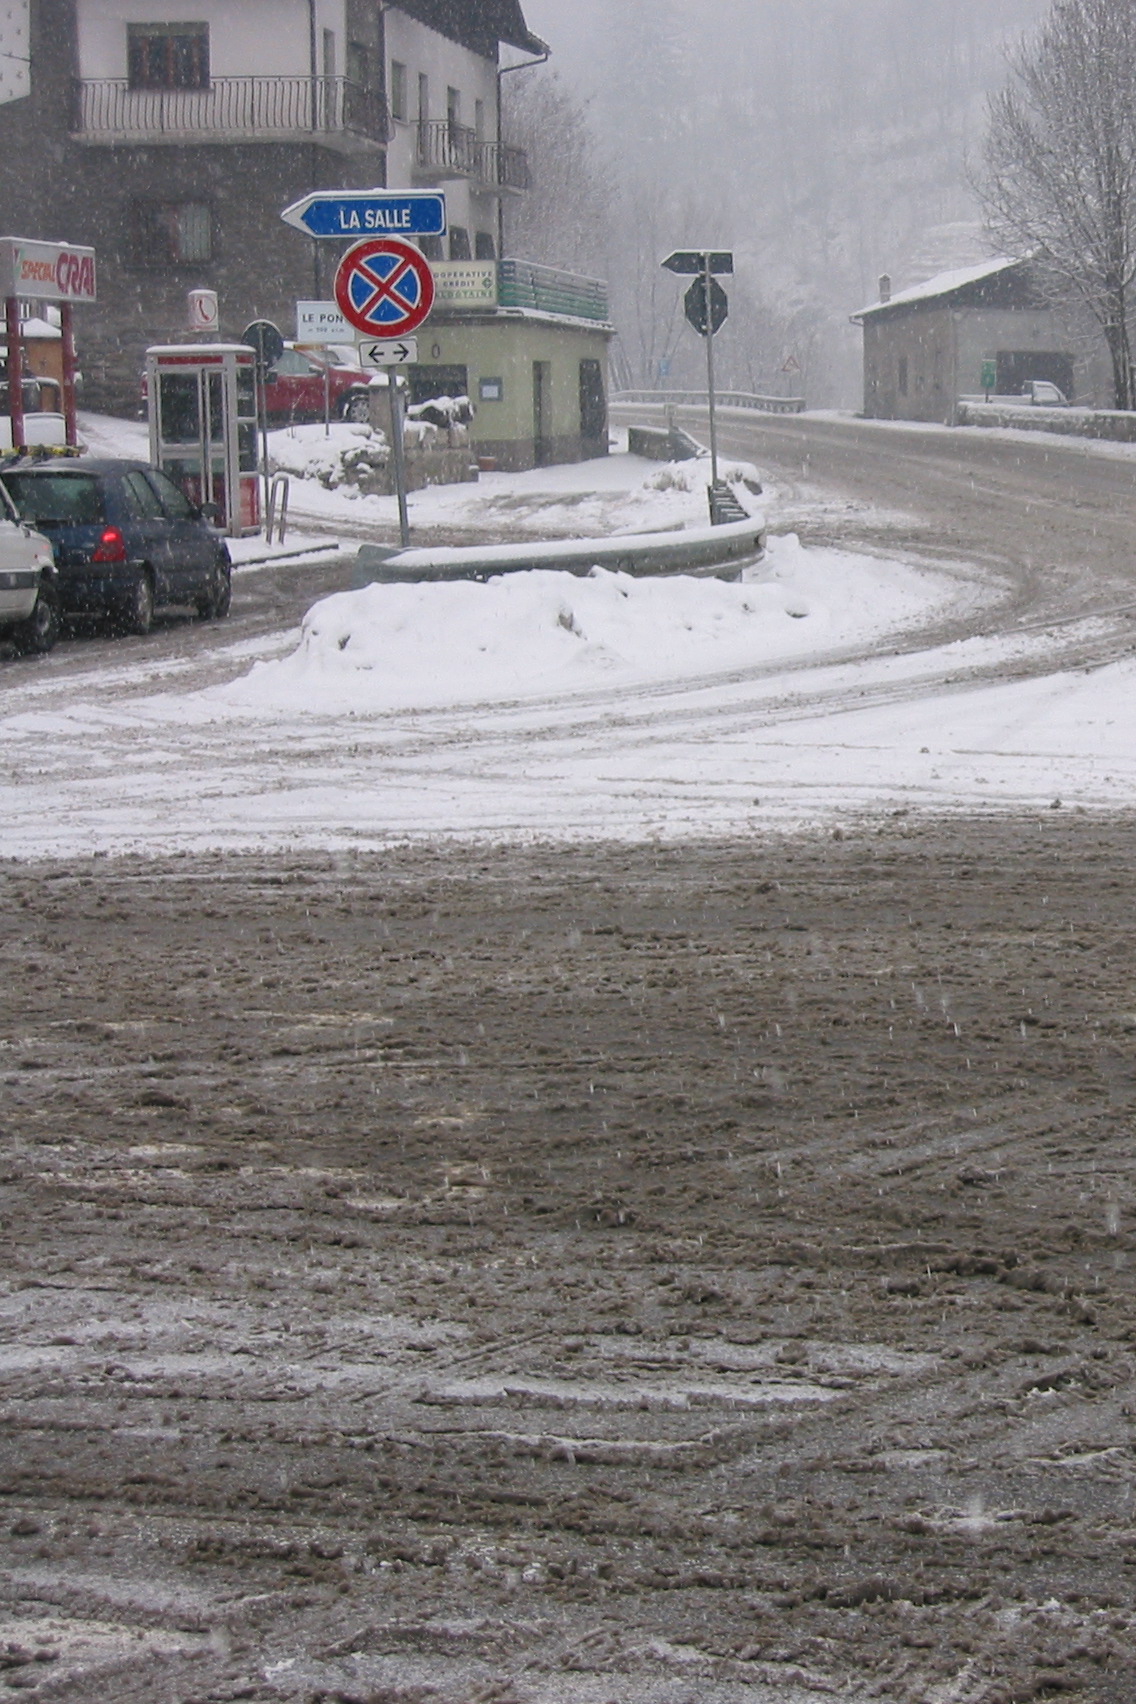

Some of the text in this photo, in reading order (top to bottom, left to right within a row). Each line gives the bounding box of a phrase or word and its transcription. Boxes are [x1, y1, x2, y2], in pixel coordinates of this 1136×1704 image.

[340, 208, 411, 229] LA SALLE
[302, 313, 344, 323] LE PON
